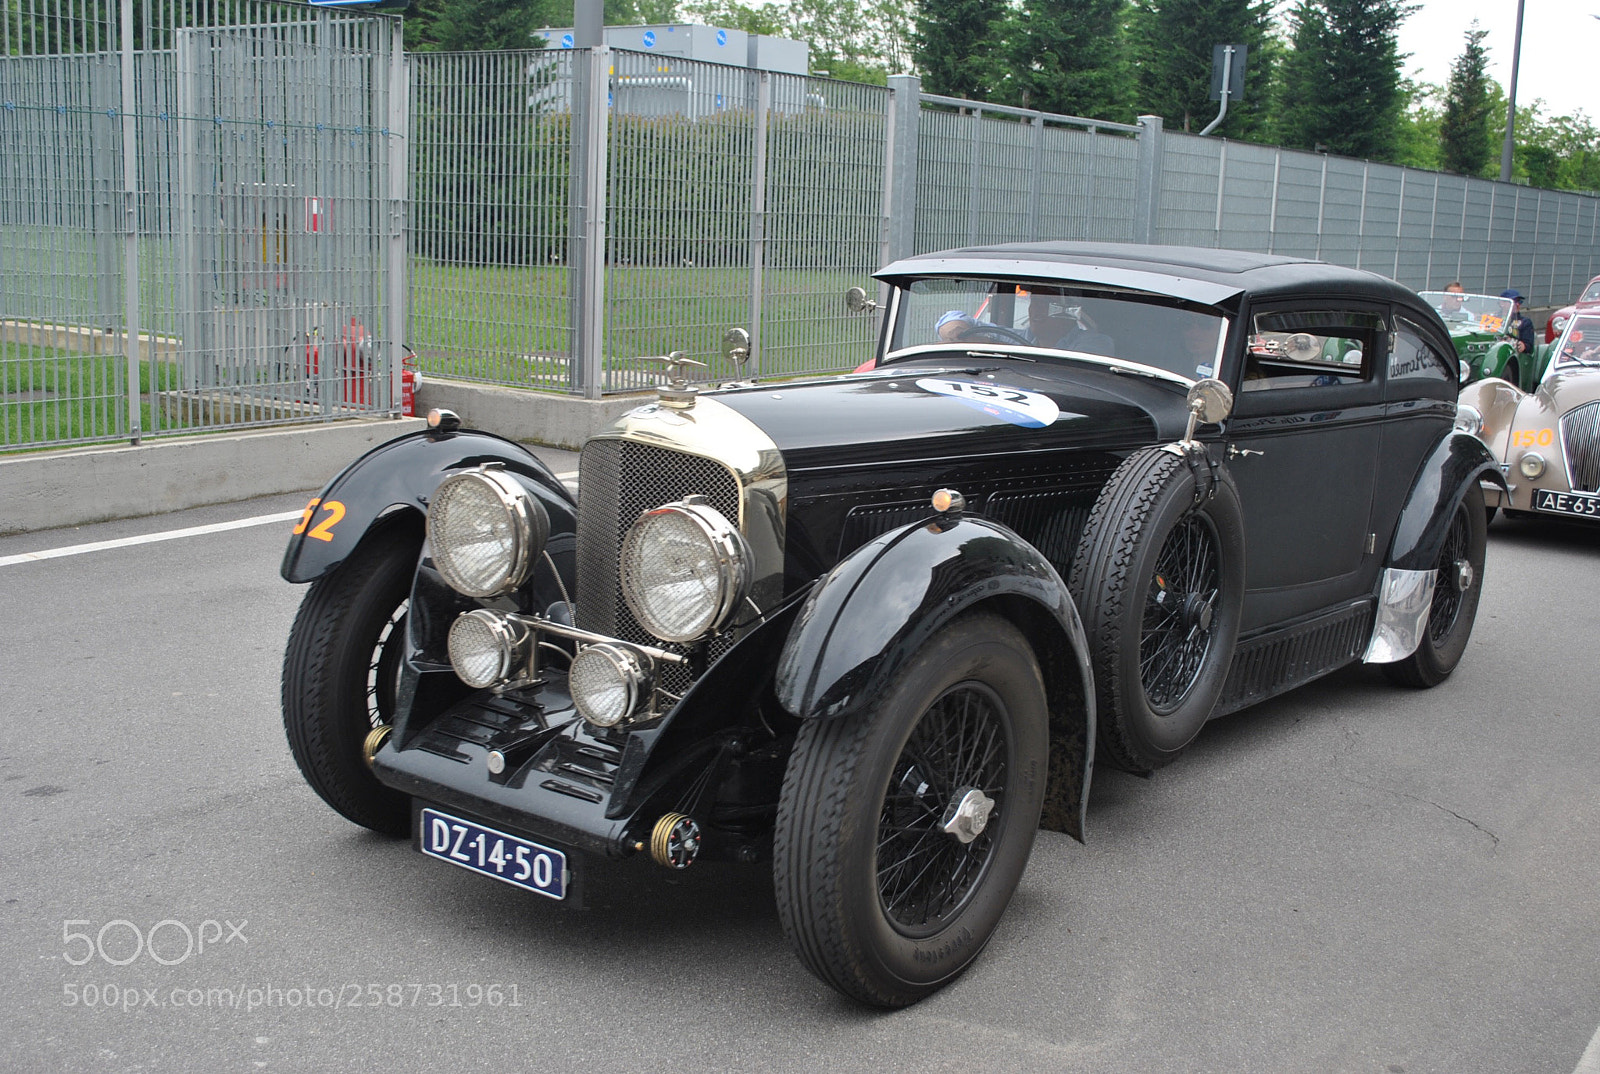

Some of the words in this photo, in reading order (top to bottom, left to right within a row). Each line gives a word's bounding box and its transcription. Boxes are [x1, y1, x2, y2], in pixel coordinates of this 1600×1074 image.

[1479, 314, 1504, 329] 175
[944, 383, 1031, 406] 152
[1512, 428, 1554, 447] 150
[431, 818, 553, 888] DZ-14-50
